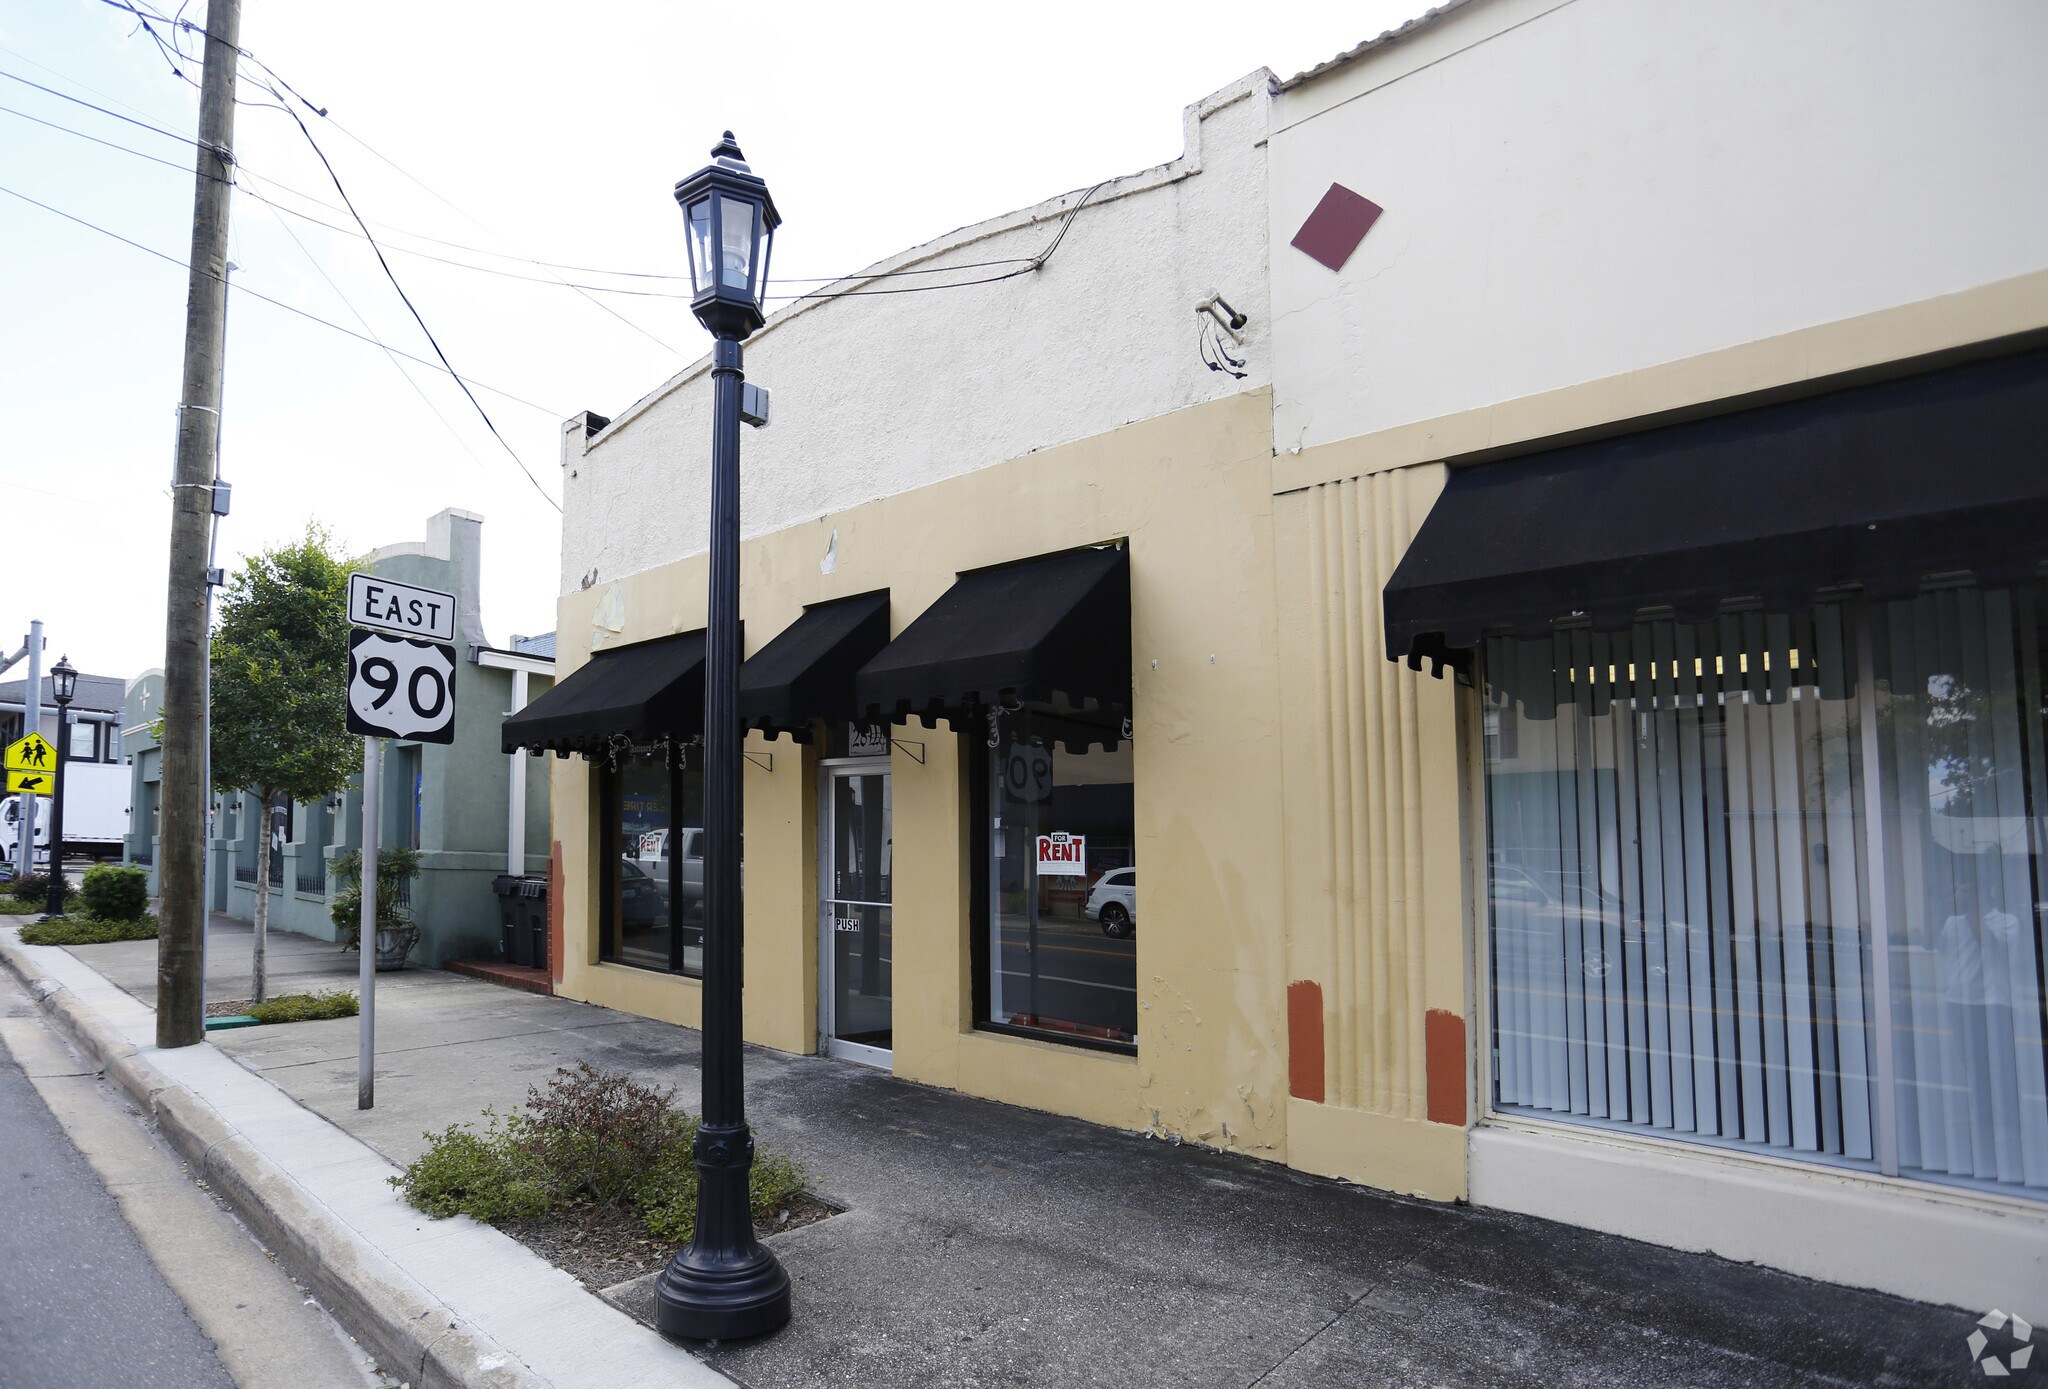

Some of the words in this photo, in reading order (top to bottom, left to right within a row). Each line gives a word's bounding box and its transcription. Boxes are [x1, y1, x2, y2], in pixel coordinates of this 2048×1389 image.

[365, 585, 441, 630] EAST
[360, 656, 446, 719] 90
[1039, 838, 1082, 862] RENT
[836, 918, 859, 931] PUSH
